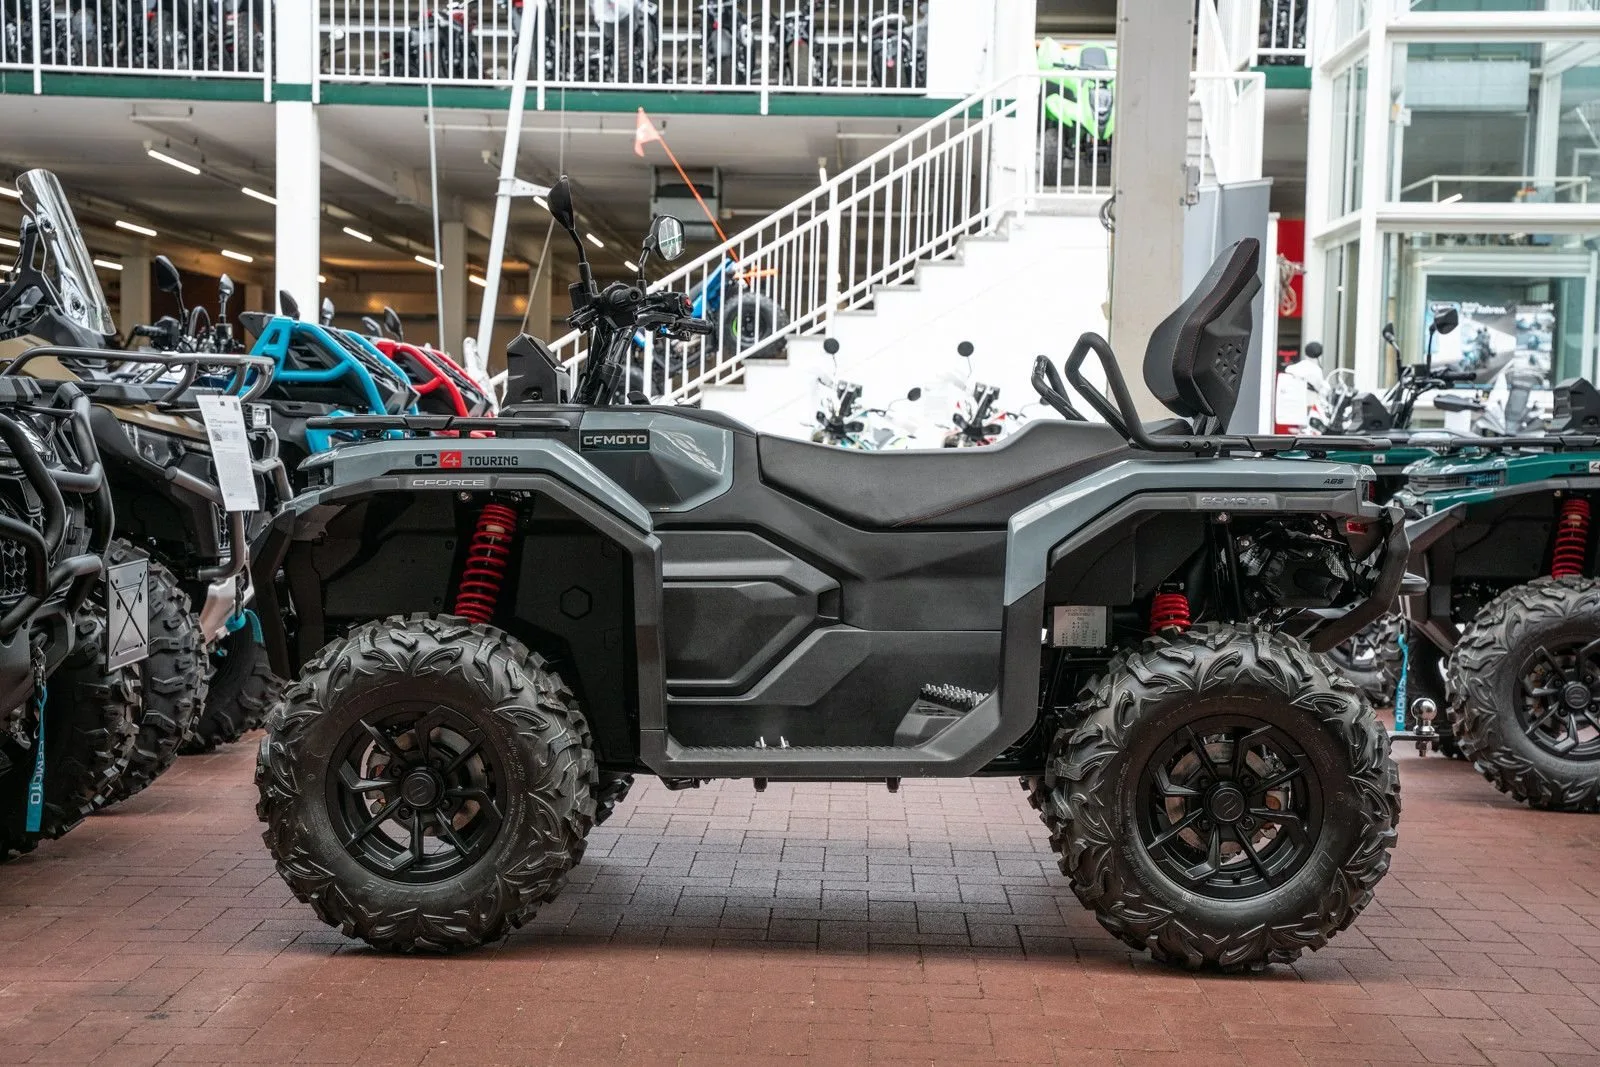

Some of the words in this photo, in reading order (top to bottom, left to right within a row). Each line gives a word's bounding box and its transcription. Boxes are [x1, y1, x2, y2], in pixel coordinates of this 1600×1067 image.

[583, 434, 648, 446] CFMOTO
[467, 456, 519, 466] TOURING
[412, 478, 485, 487] CFORCE
